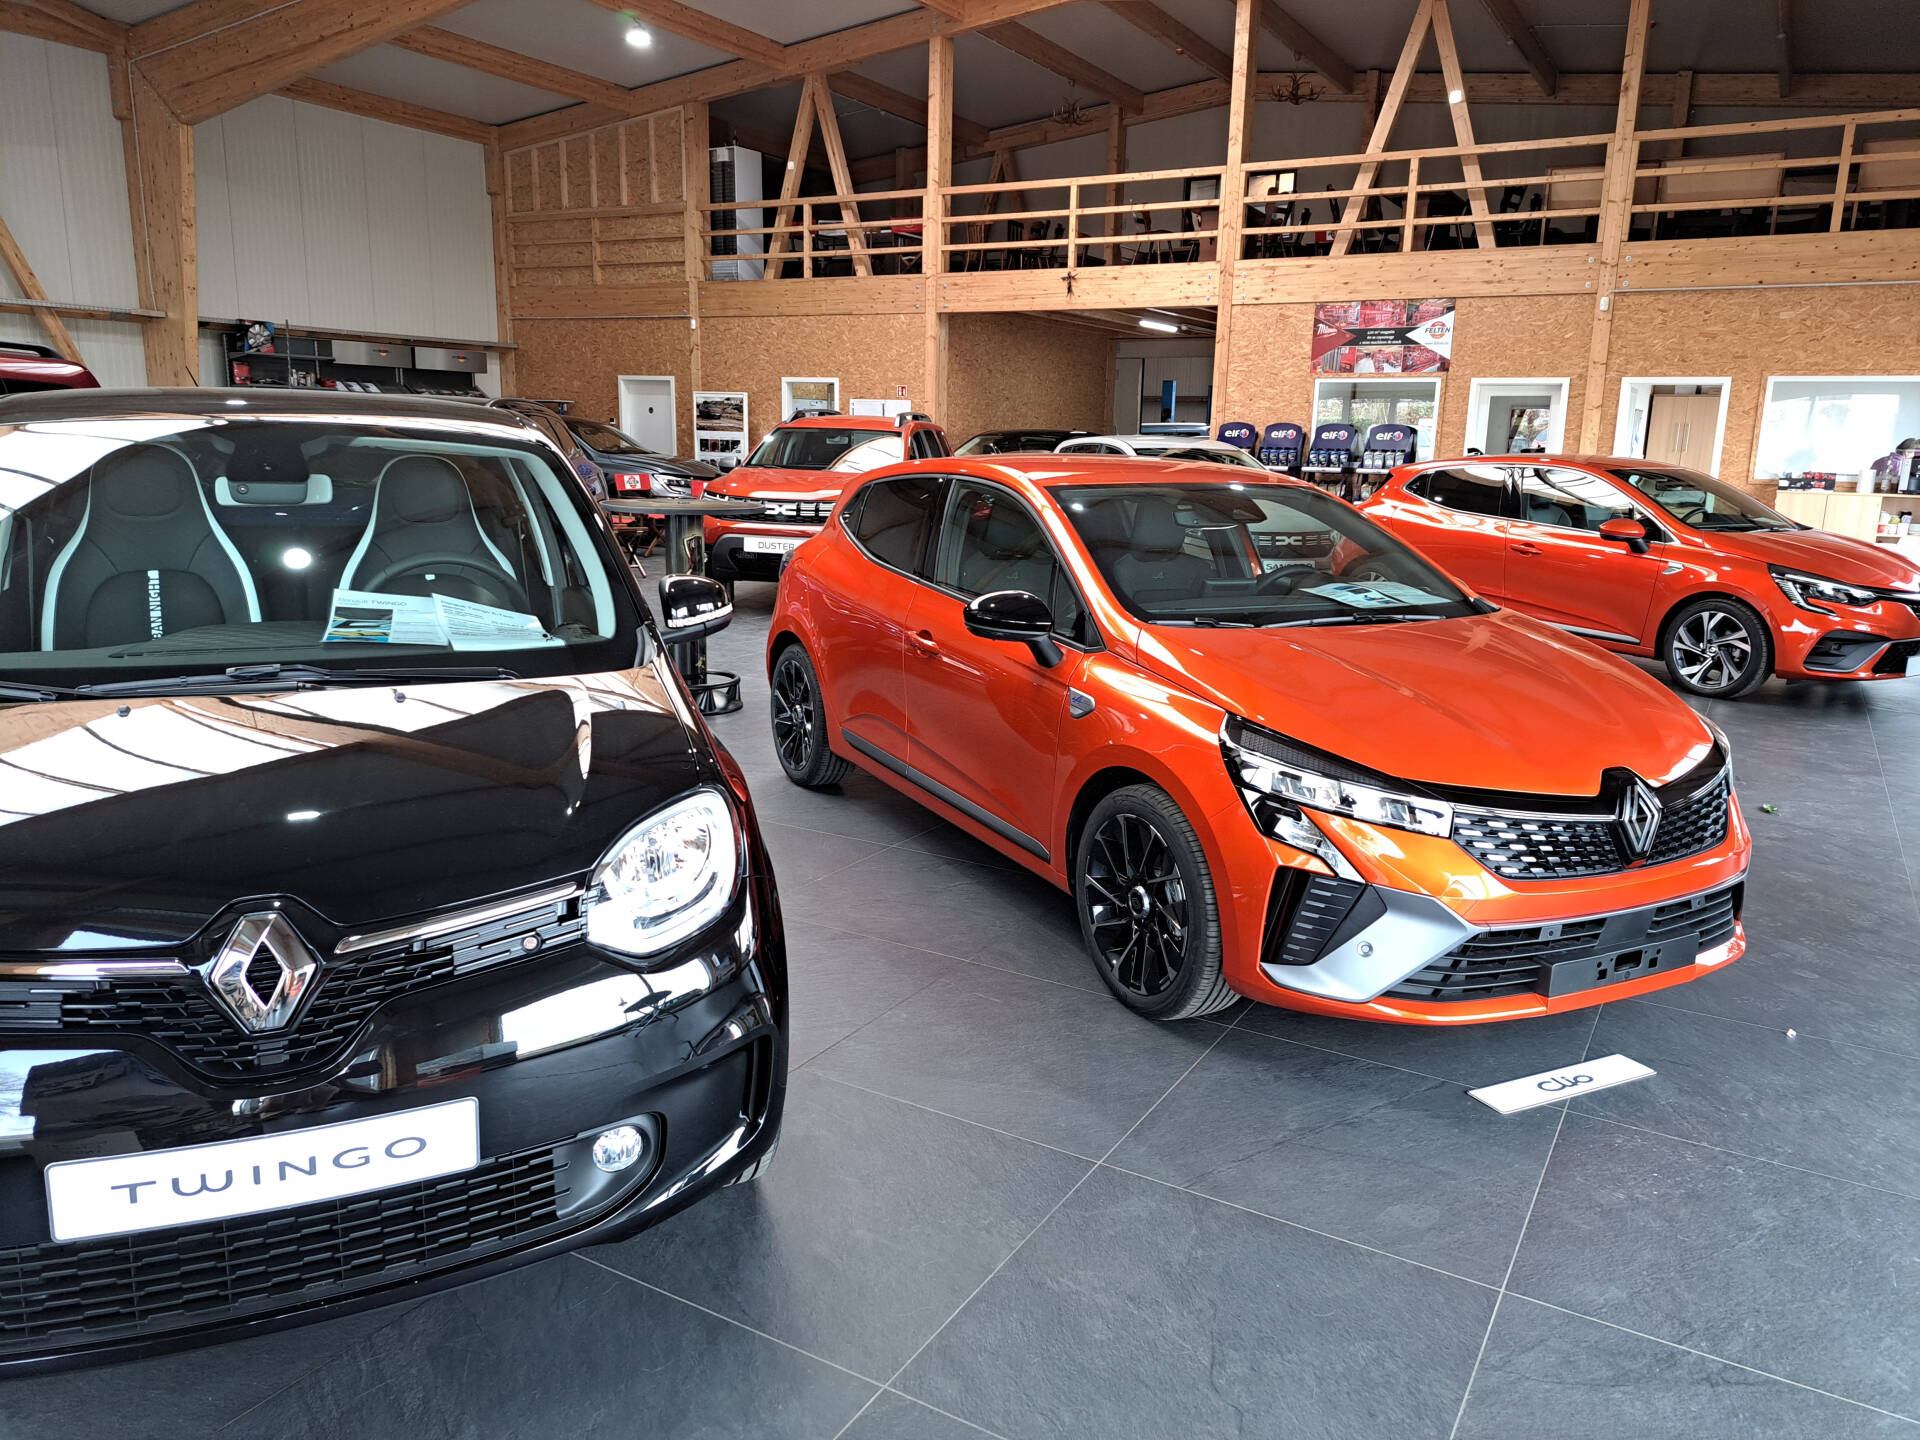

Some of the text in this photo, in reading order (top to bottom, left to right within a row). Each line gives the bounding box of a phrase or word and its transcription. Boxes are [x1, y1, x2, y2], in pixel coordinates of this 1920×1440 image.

[1224, 429, 1241, 438] elf
[1270, 429, 1287, 439] elf
[1321, 431, 1338, 440] elf
[1375, 432, 1394, 441] elf
[758, 541, 795, 551] DUSTER
[111, 1136, 427, 1204] TWINGO
